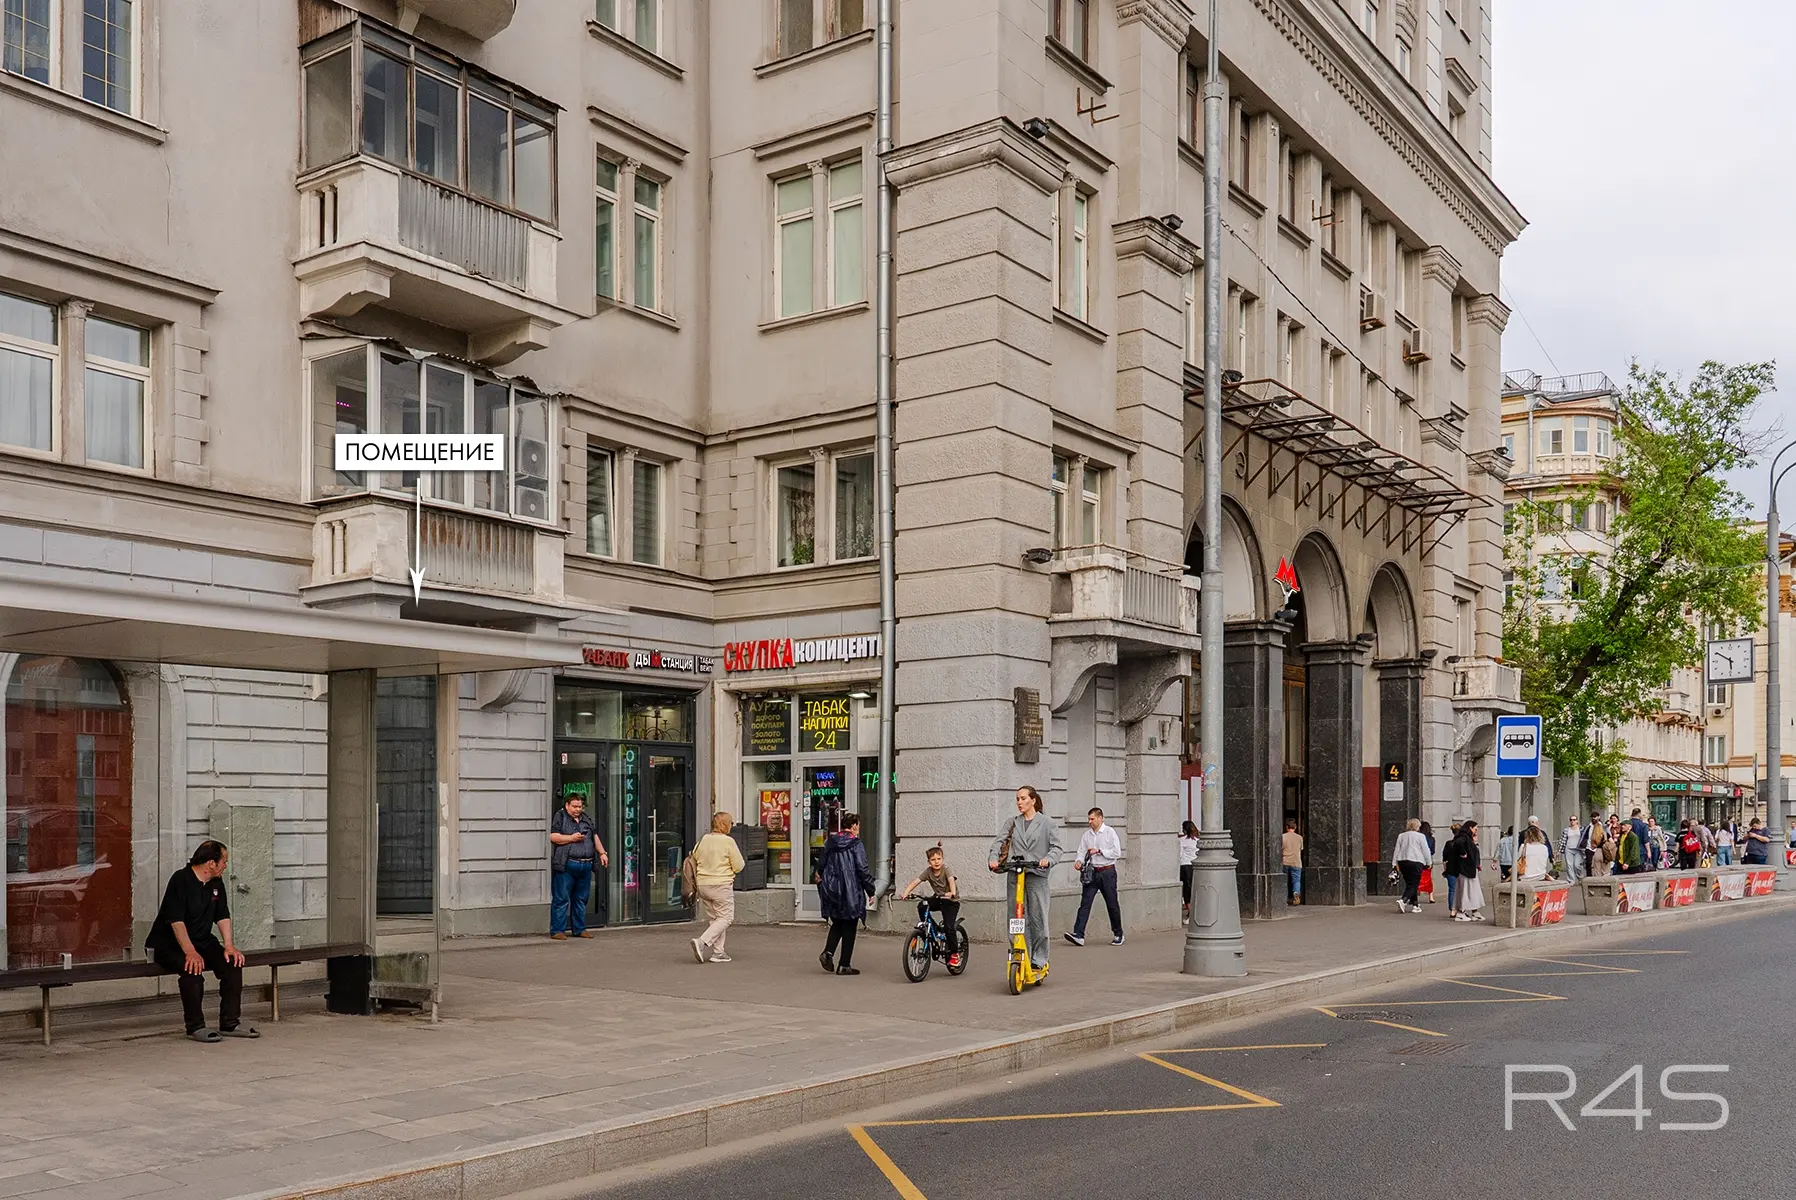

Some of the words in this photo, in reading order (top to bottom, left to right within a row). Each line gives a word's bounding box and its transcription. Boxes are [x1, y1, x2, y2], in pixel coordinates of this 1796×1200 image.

[723, 638, 796, 671] СКУПКА
[749, 702, 788, 712] АУРУМ
[804, 698, 849, 717] ТАБАК
[755, 714, 781, 722] ДОРОГО
[803, 716, 849, 731] НАПИТКИ
[755, 730, 781, 738] ЗОЛОТО
[814, 731, 836, 750] 24
[815, 772, 835, 780] ТАБАК
[1389, 764, 1399, 776] 4
[1650, 783, 1687, 791] COFFEE
[625, 749, 635, 848] ОТКРЫТО
